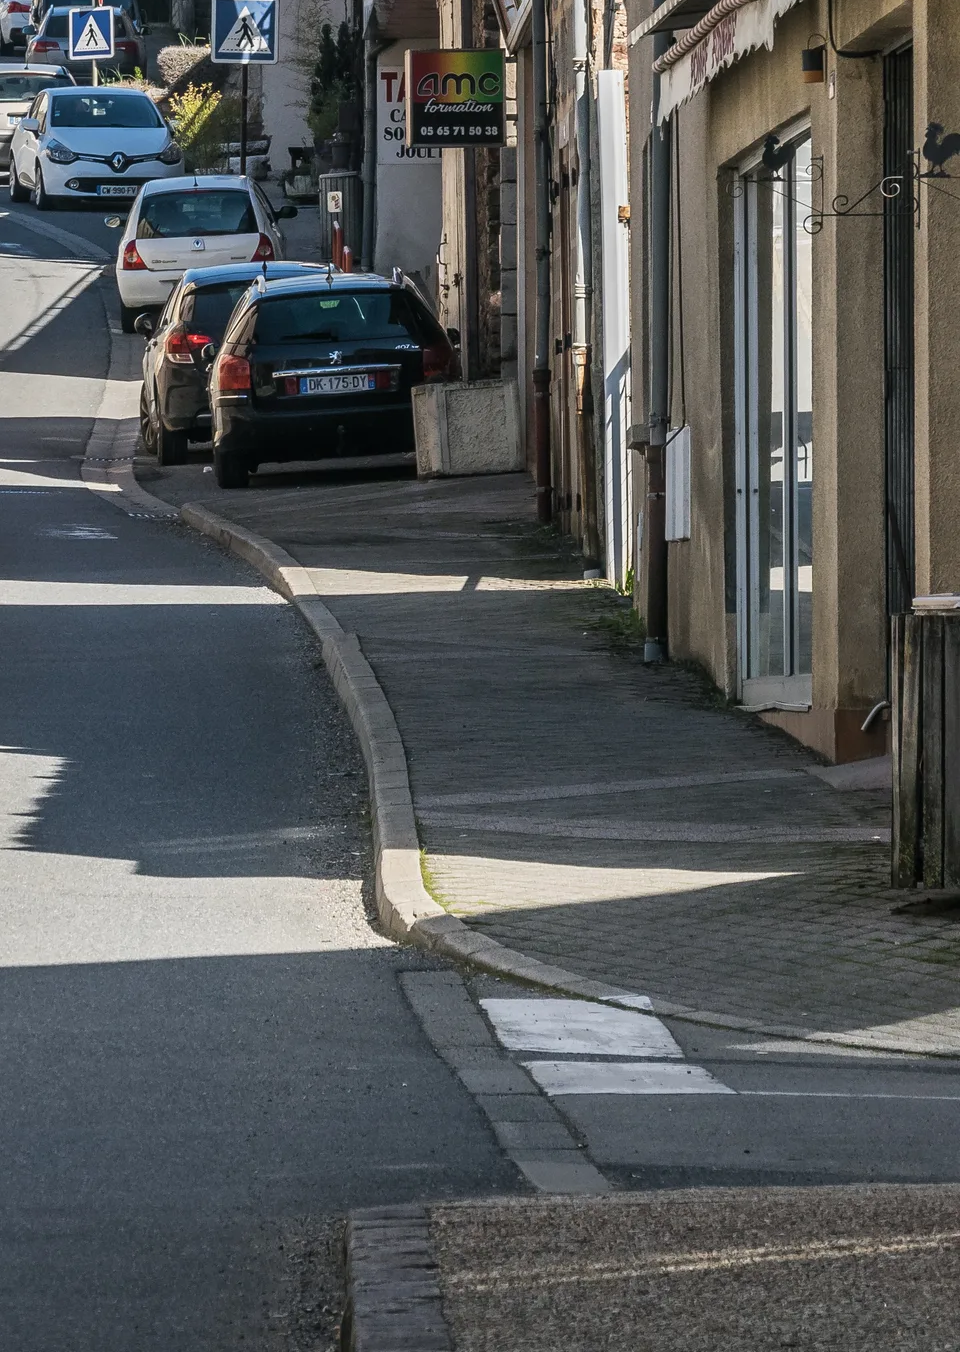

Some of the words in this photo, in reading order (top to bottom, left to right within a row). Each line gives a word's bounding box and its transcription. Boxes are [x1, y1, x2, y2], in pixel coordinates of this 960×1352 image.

[424, 97, 494, 113] formation
[384, 127, 407, 141] SO
[421, 127, 433, 136] 05
[437, 127, 449, 136] 65
[453, 127, 465, 136] 71
[469, 127, 482, 136] 50
[485, 127, 498, 136] 38
[308, 375, 367, 392] DK-175-DY
